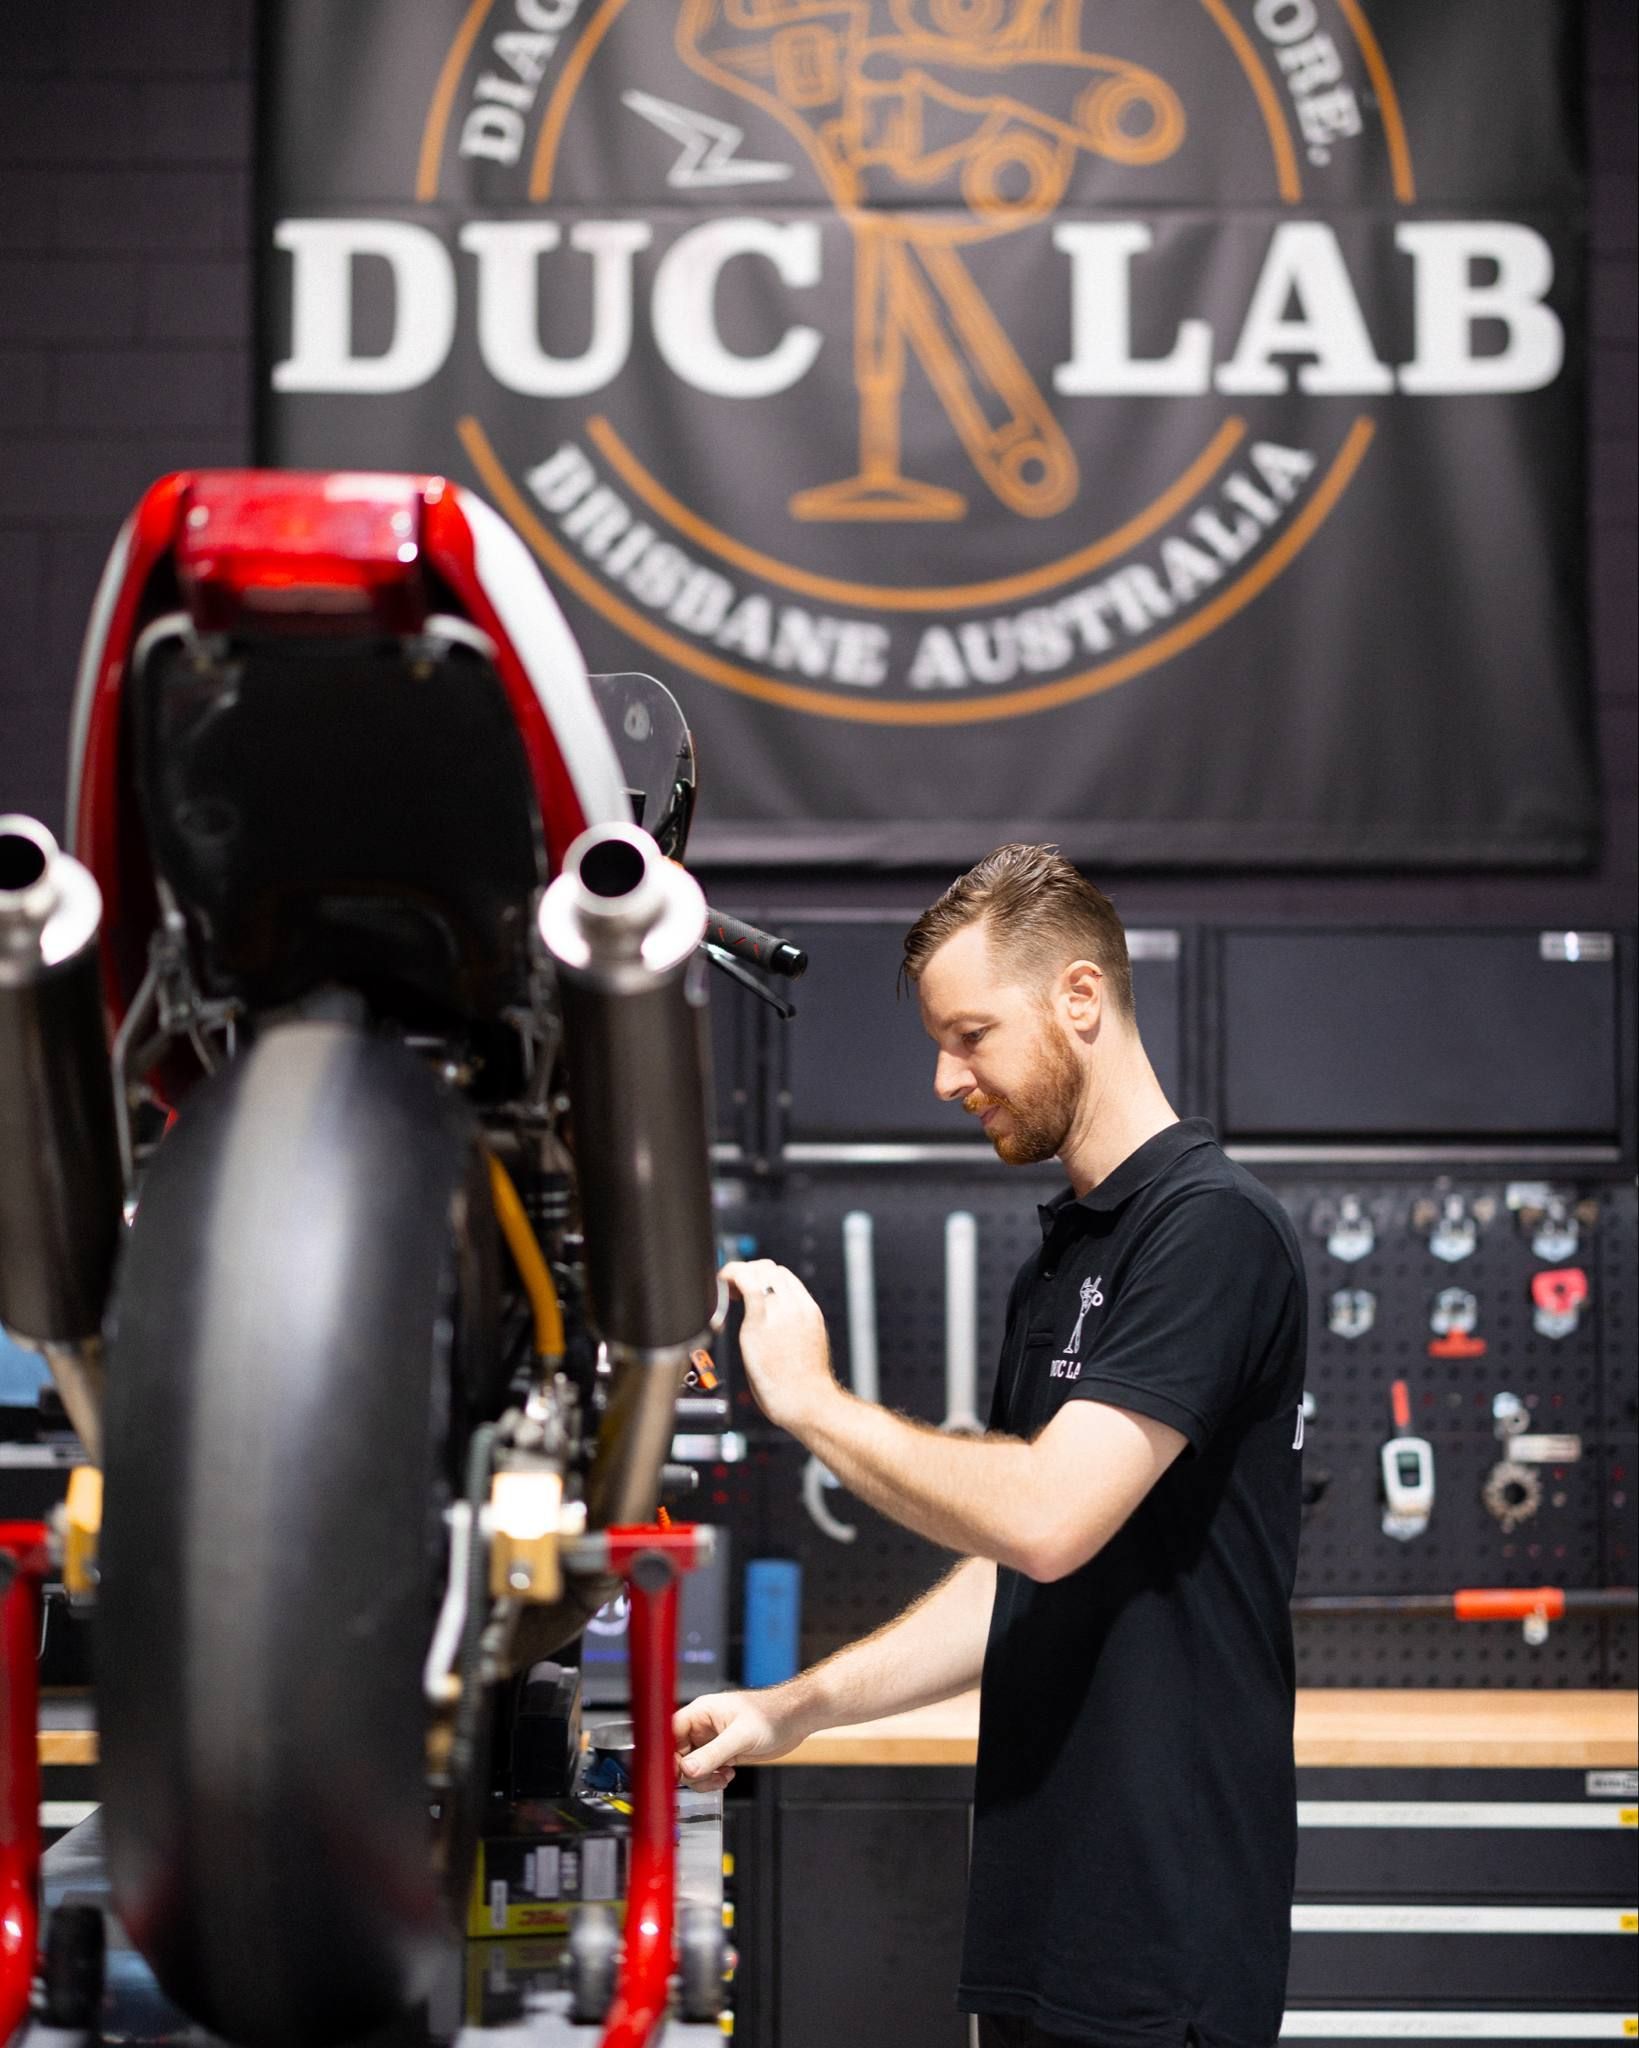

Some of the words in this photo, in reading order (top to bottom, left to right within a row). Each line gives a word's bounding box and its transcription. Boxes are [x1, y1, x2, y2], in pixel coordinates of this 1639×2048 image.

[272, 216, 823, 399] DUC
[1052, 219, 1565, 396] LAB
[525, 442, 890, 689] BRISBANE
[909, 441, 1316, 690] AUSTRALIA
